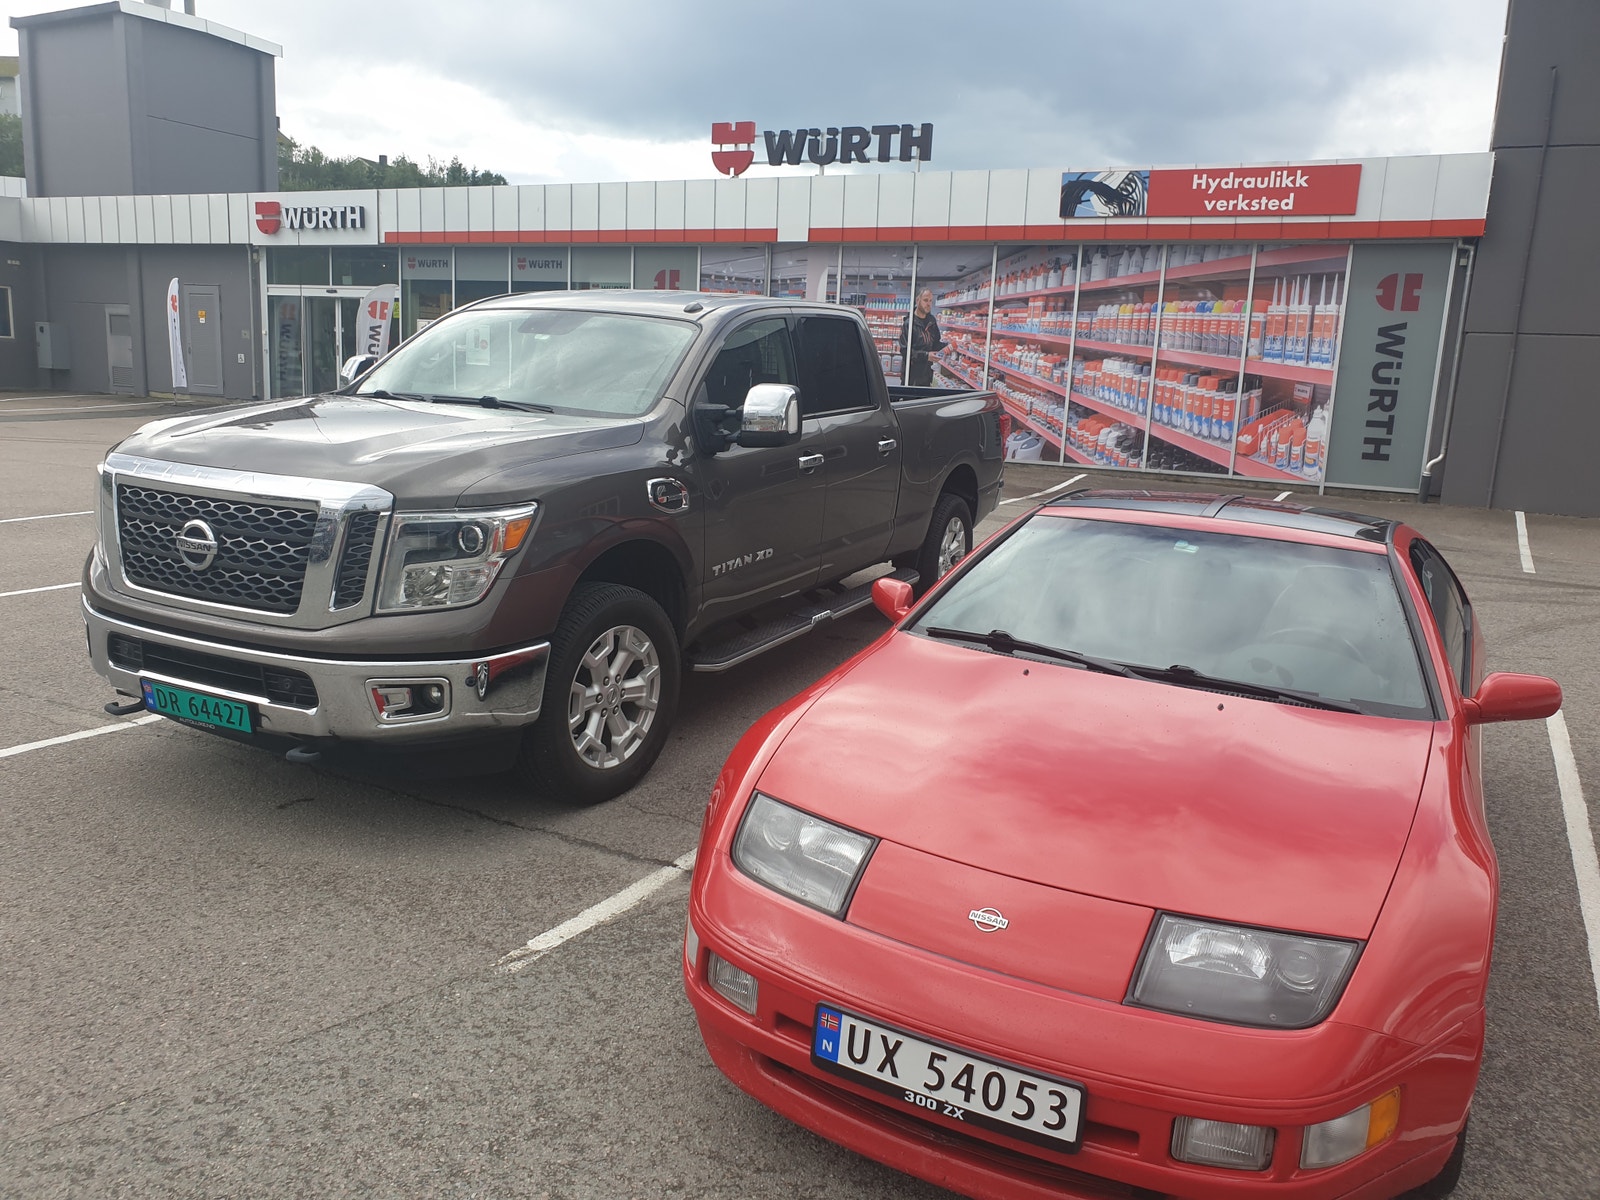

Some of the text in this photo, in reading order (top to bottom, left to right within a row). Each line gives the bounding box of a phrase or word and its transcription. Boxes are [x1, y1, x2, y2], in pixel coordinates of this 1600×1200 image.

[764, 123, 933, 166] WÜRTH
[1192, 170, 1310, 194] Hydraulikk
[1204, 193, 1295, 211] verksted
[281, 206, 365, 230] WÜRTH
[417, 259, 448, 268] WÜRTH
[528, 259, 563, 269] WÜRTH
[1361, 322, 1408, 461] WÜRTH
[177, 538, 211, 552] NISSAN
[712, 548, 774, 576] TITAN XD
[155, 687, 244, 726] DR 64427
[970, 912, 1007, 926] NISSAN
[822, 1039, 833, 1053] N
[847, 1023, 1068, 1131] UX 54053
[904, 1090, 965, 1121] 300 ZX
